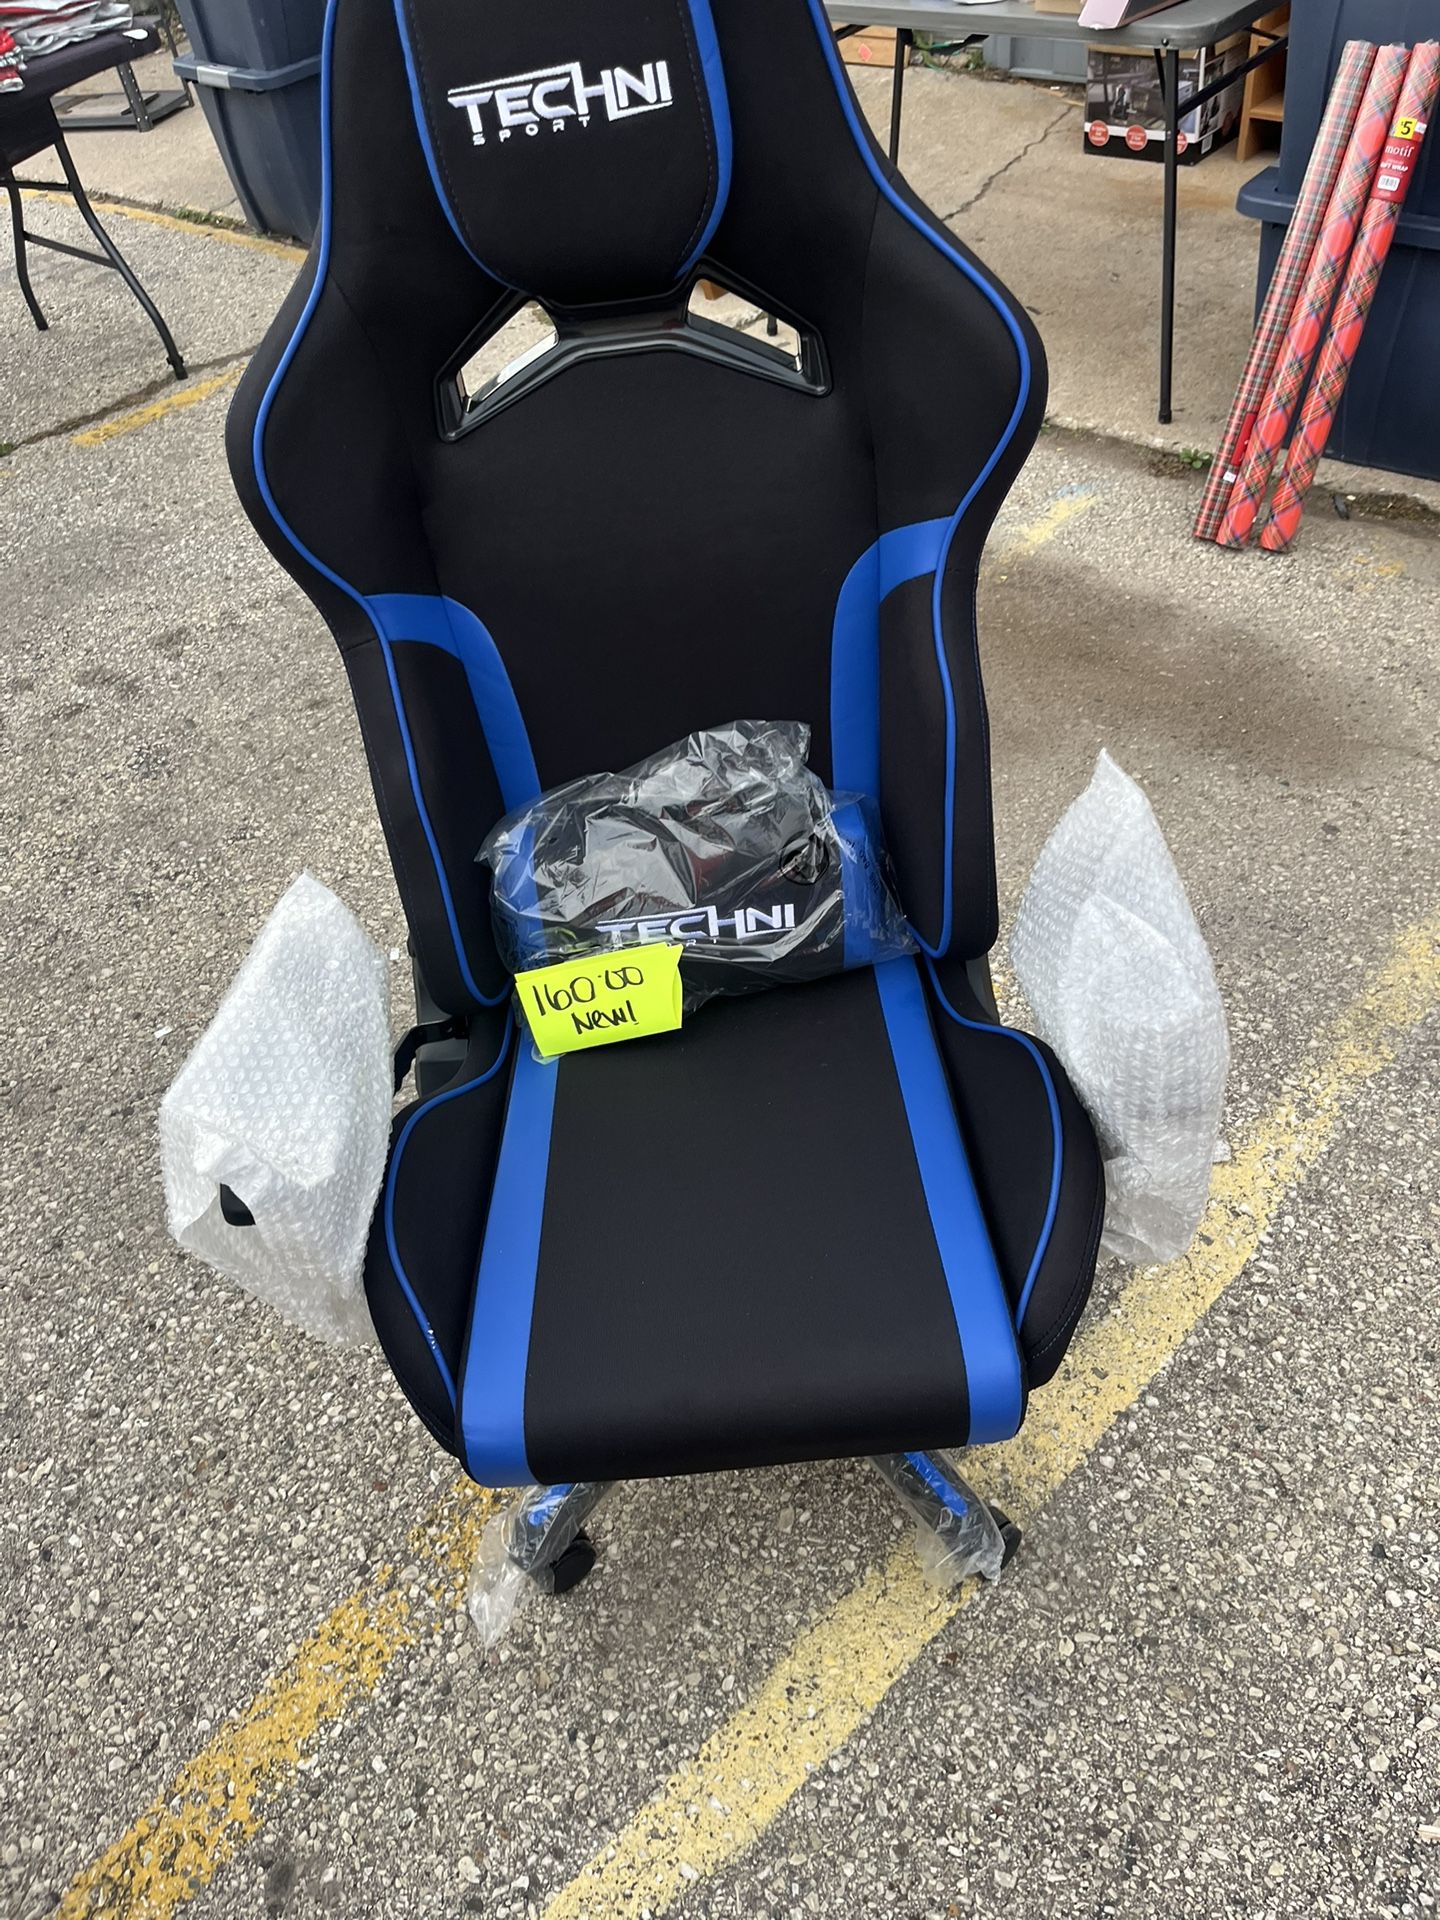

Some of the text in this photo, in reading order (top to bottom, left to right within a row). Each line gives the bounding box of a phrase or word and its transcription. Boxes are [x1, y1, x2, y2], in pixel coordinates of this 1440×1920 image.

[448, 61, 673, 134] TECHNI
[473, 115, 590, 146] SPORT
[1384, 145, 1415, 157] motif
[595, 904, 795, 947] TECHNI
